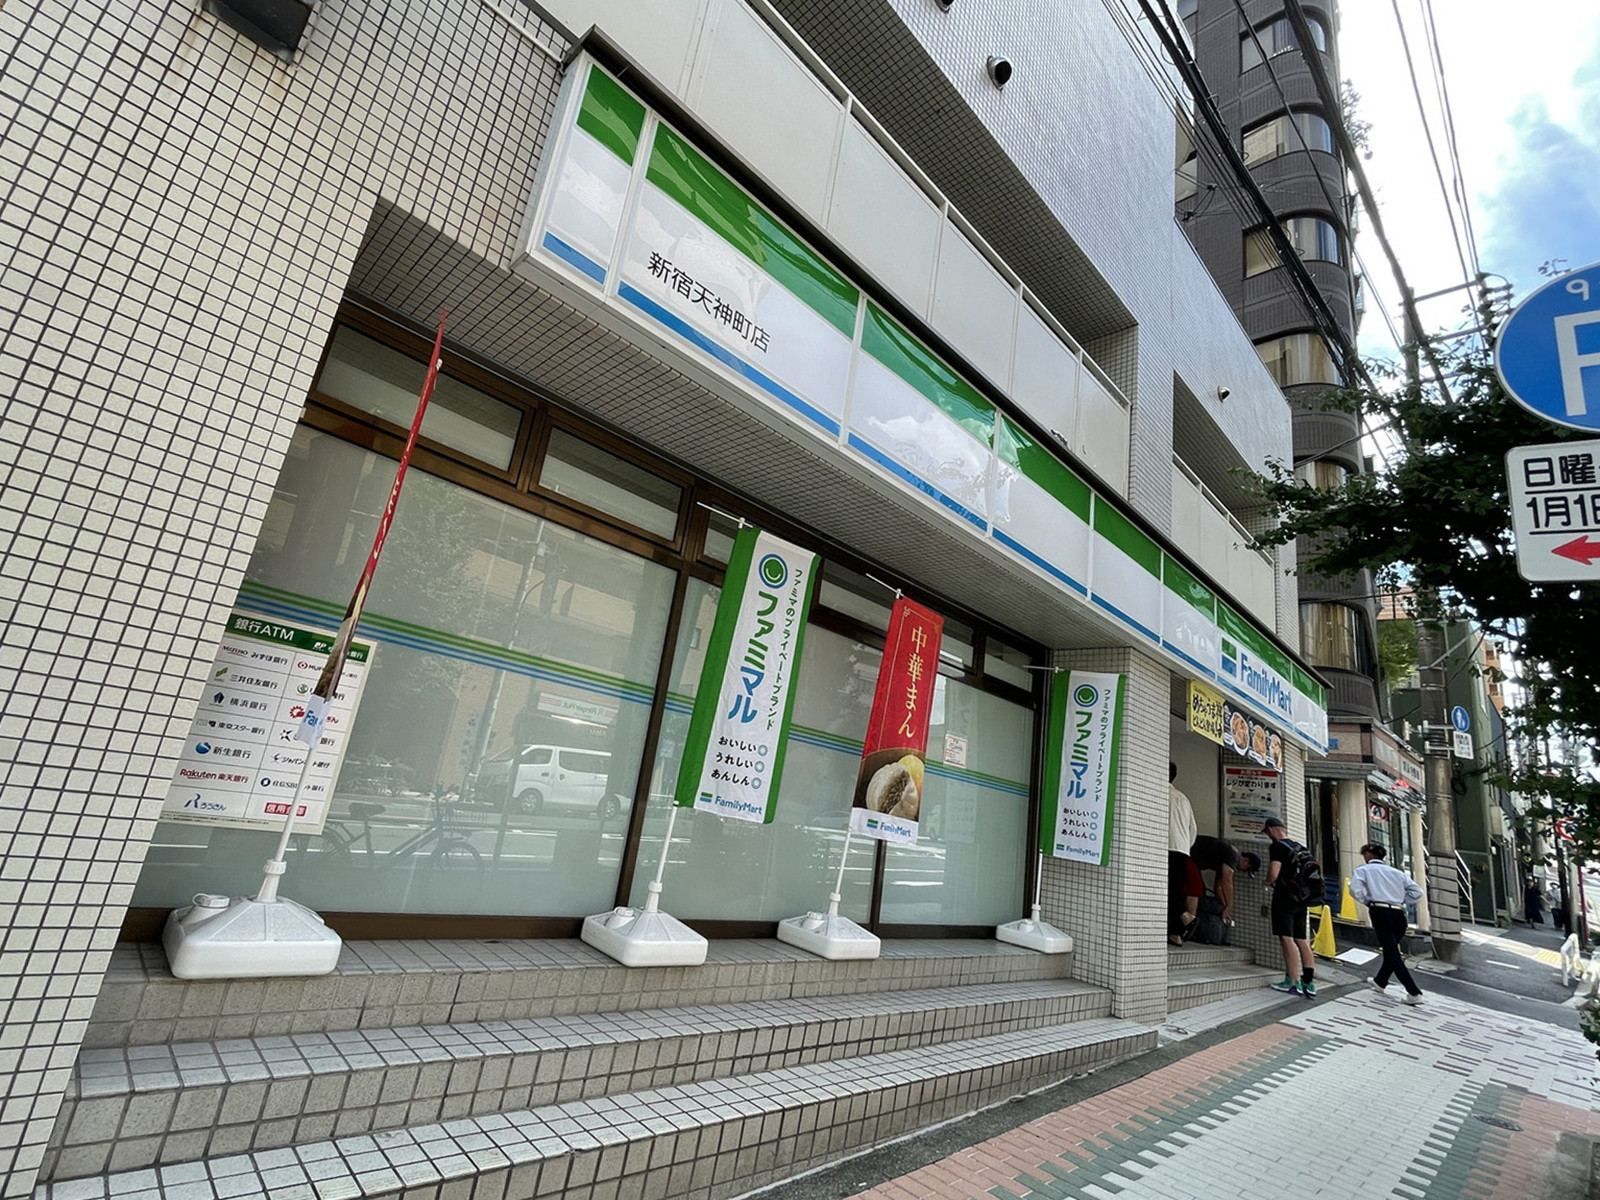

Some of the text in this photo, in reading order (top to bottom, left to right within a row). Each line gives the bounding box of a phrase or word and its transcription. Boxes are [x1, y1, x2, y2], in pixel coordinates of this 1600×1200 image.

[647, 251, 771, 354] 新宿天神町店
[1523, 453, 1600, 488] 日曜
[234, 618, 295, 641] 銀行ATM
[251, 652, 288, 666] みずほ銀行
[728, 590, 779, 724] ファミマル
[230, 673, 279, 690] 三井住友銀行
[897, 625, 928, 739] 中華まん
[1240, 652, 1293, 716] FamilyMart
[229, 697, 268, 711] 横浜銀行
[213, 746, 252, 759] 新生銀行
[1066, 710, 1093, 799] ファミマル
[179, 768, 217, 780] Rakuten
[714, 795, 763, 815] FamilyMart
[1066, 845, 1100, 858] FamilyMart
